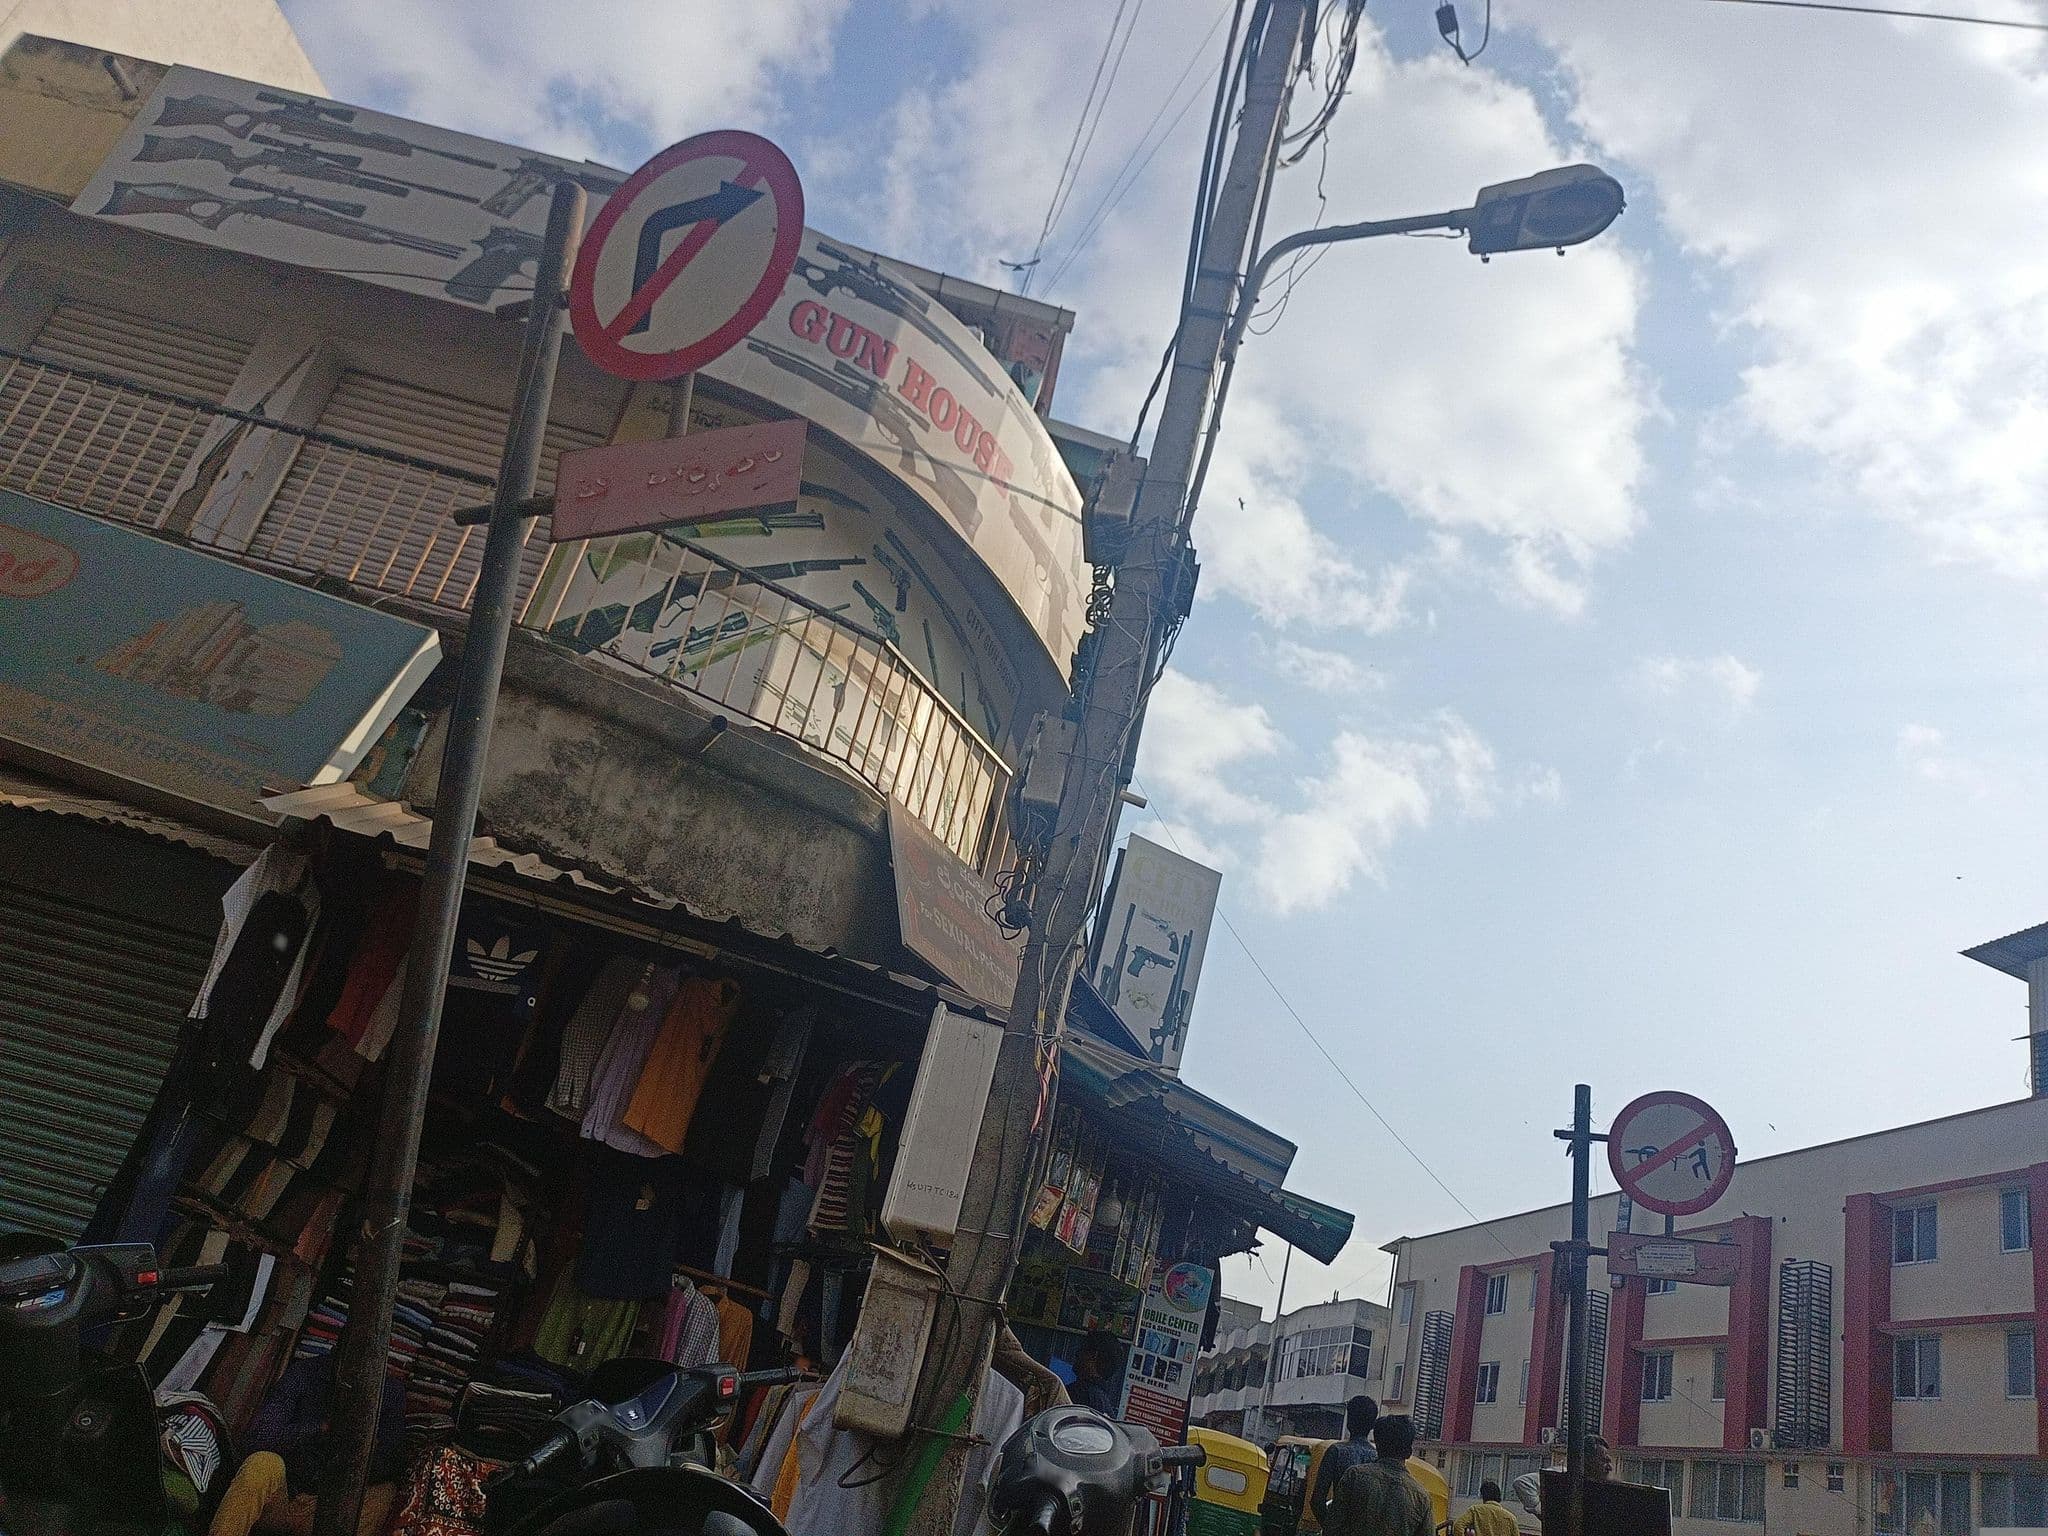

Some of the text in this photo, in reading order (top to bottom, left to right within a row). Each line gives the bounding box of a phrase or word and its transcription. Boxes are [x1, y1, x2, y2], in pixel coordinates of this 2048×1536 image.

[789, 299, 899, 379] GUN
[898, 356, 1014, 499] HOUSE
[966, 608, 986, 640] CITY
[1132, 857, 1211, 905] CITY
[932, 908, 979, 962] SEXUAL
[1142, 1307, 1199, 1335] OBILE CENTER
